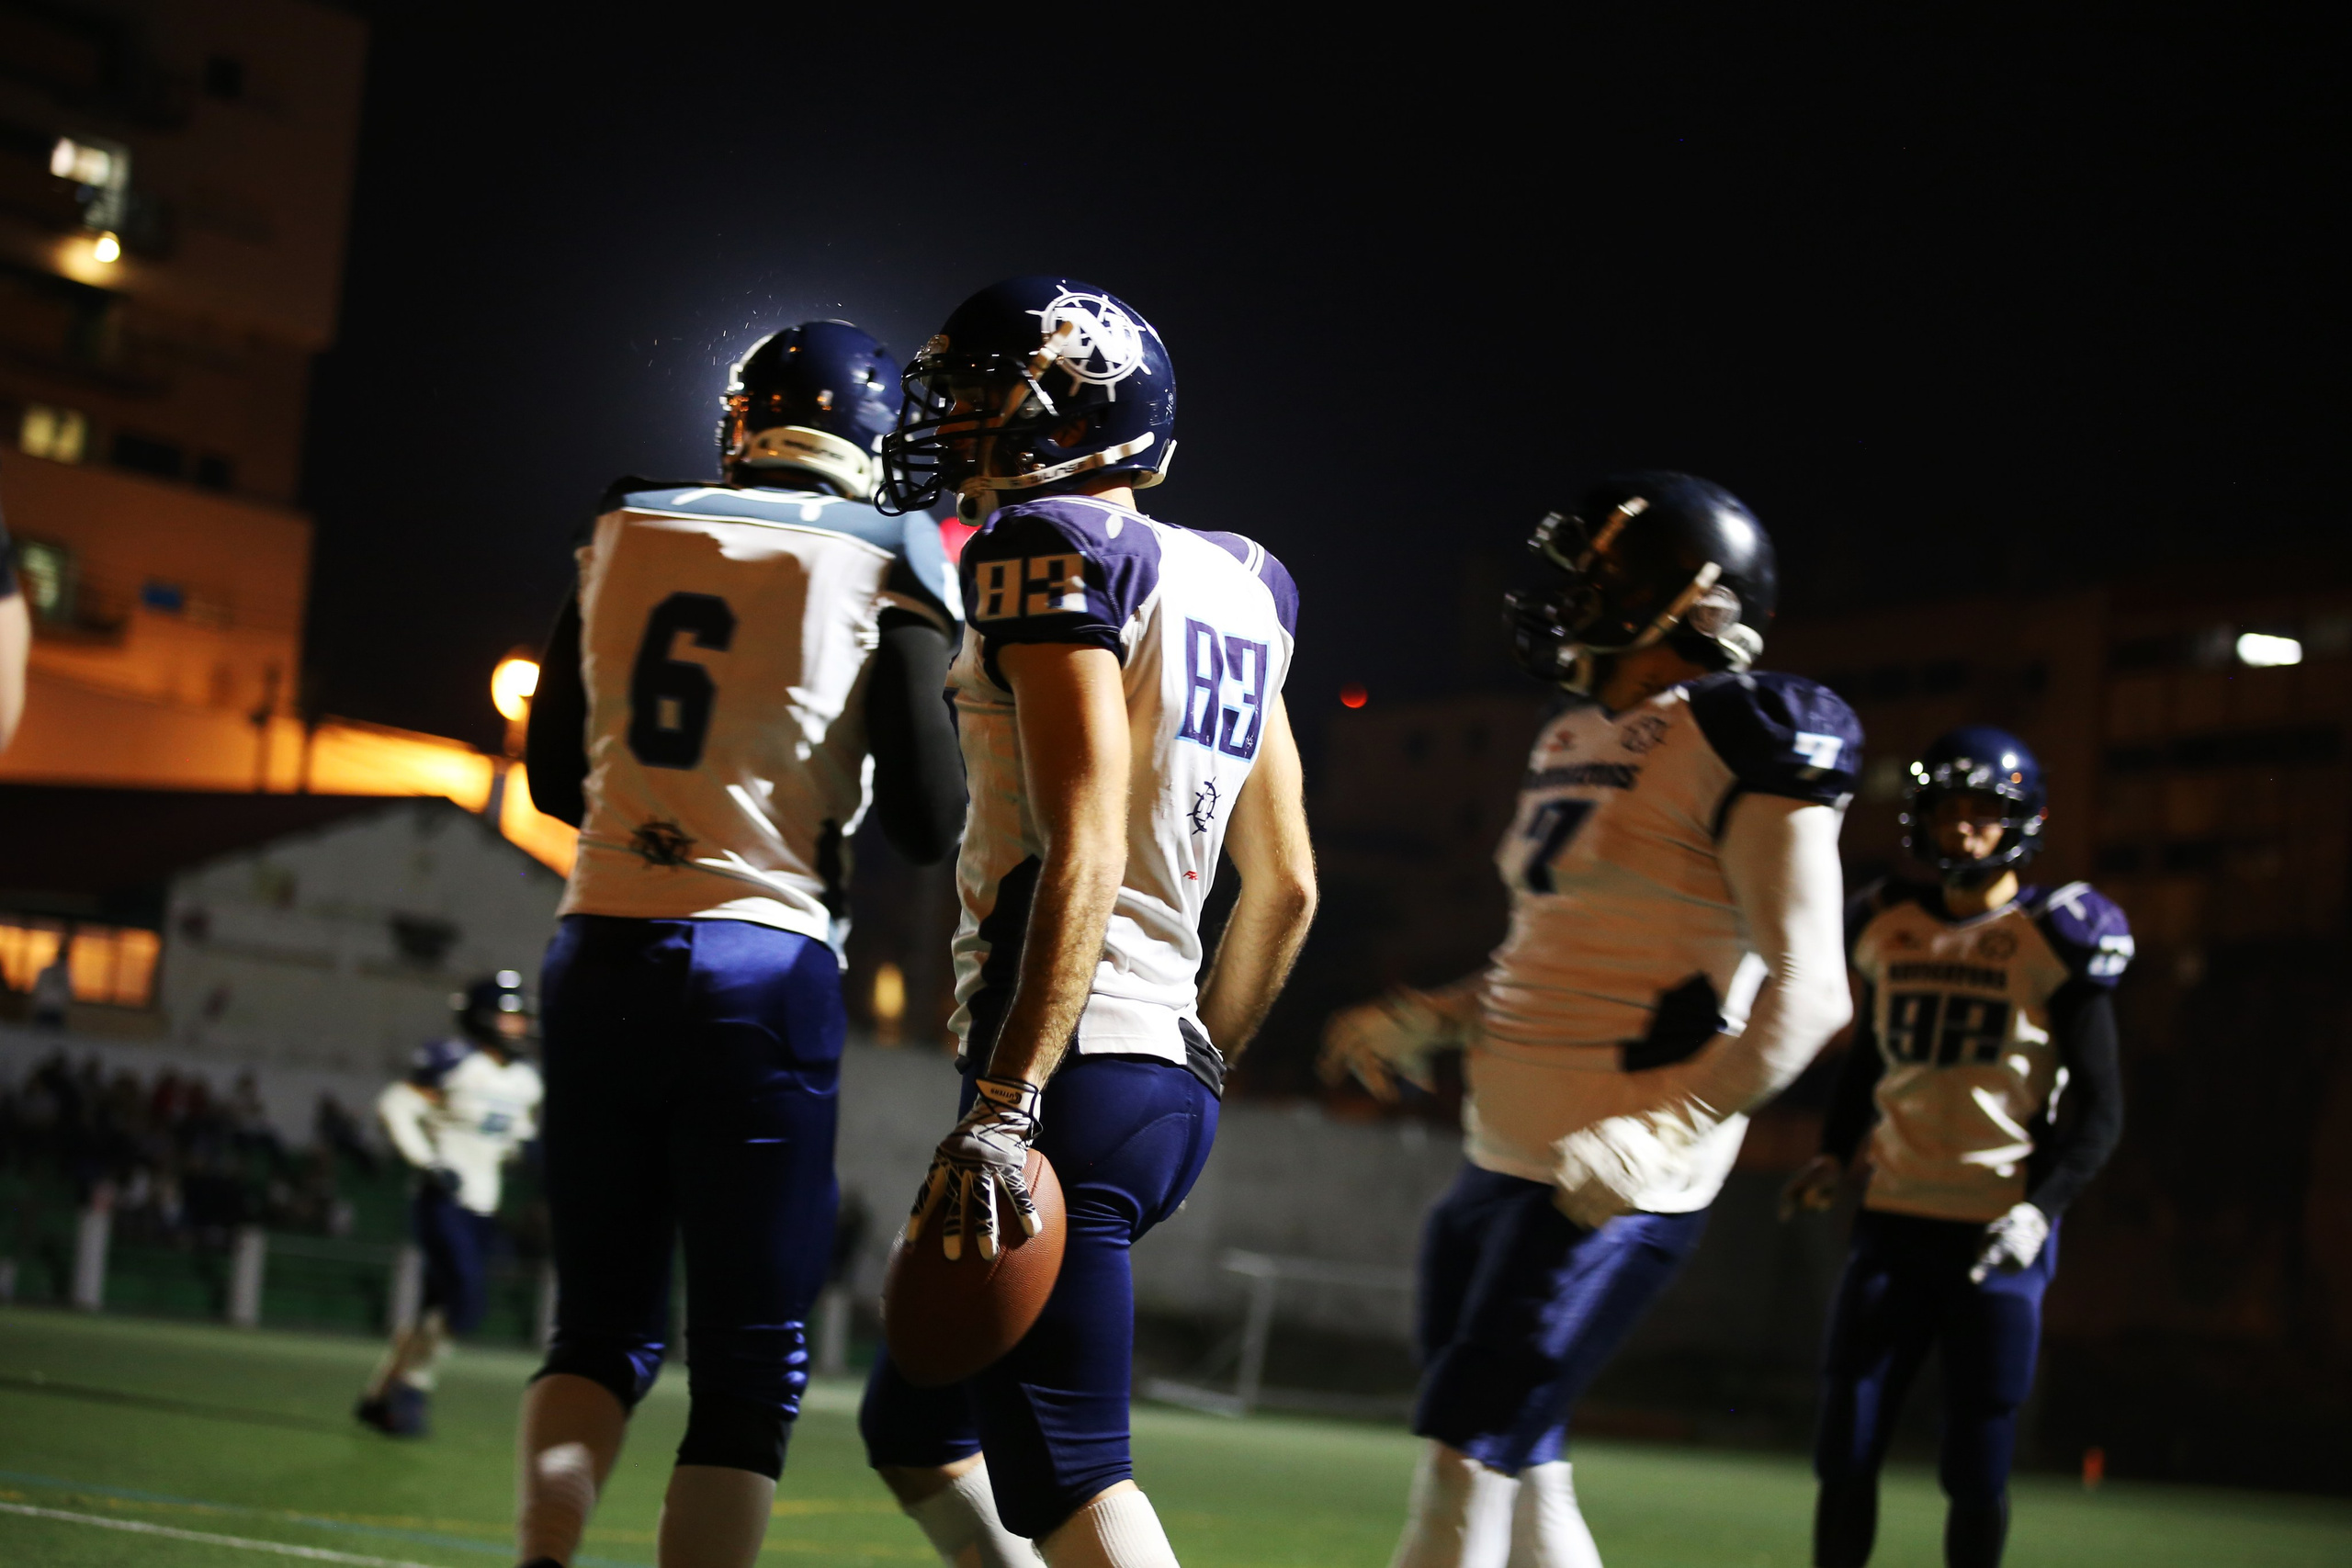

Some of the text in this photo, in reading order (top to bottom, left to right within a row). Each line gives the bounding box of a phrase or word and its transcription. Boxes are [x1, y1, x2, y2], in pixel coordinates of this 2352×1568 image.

[976, 551, 1087, 622] 83
[628, 591, 739, 771] 6
[1175, 614, 1271, 763] 83
[1792, 731, 1845, 781] 7
[1525, 798, 1599, 895] 7
